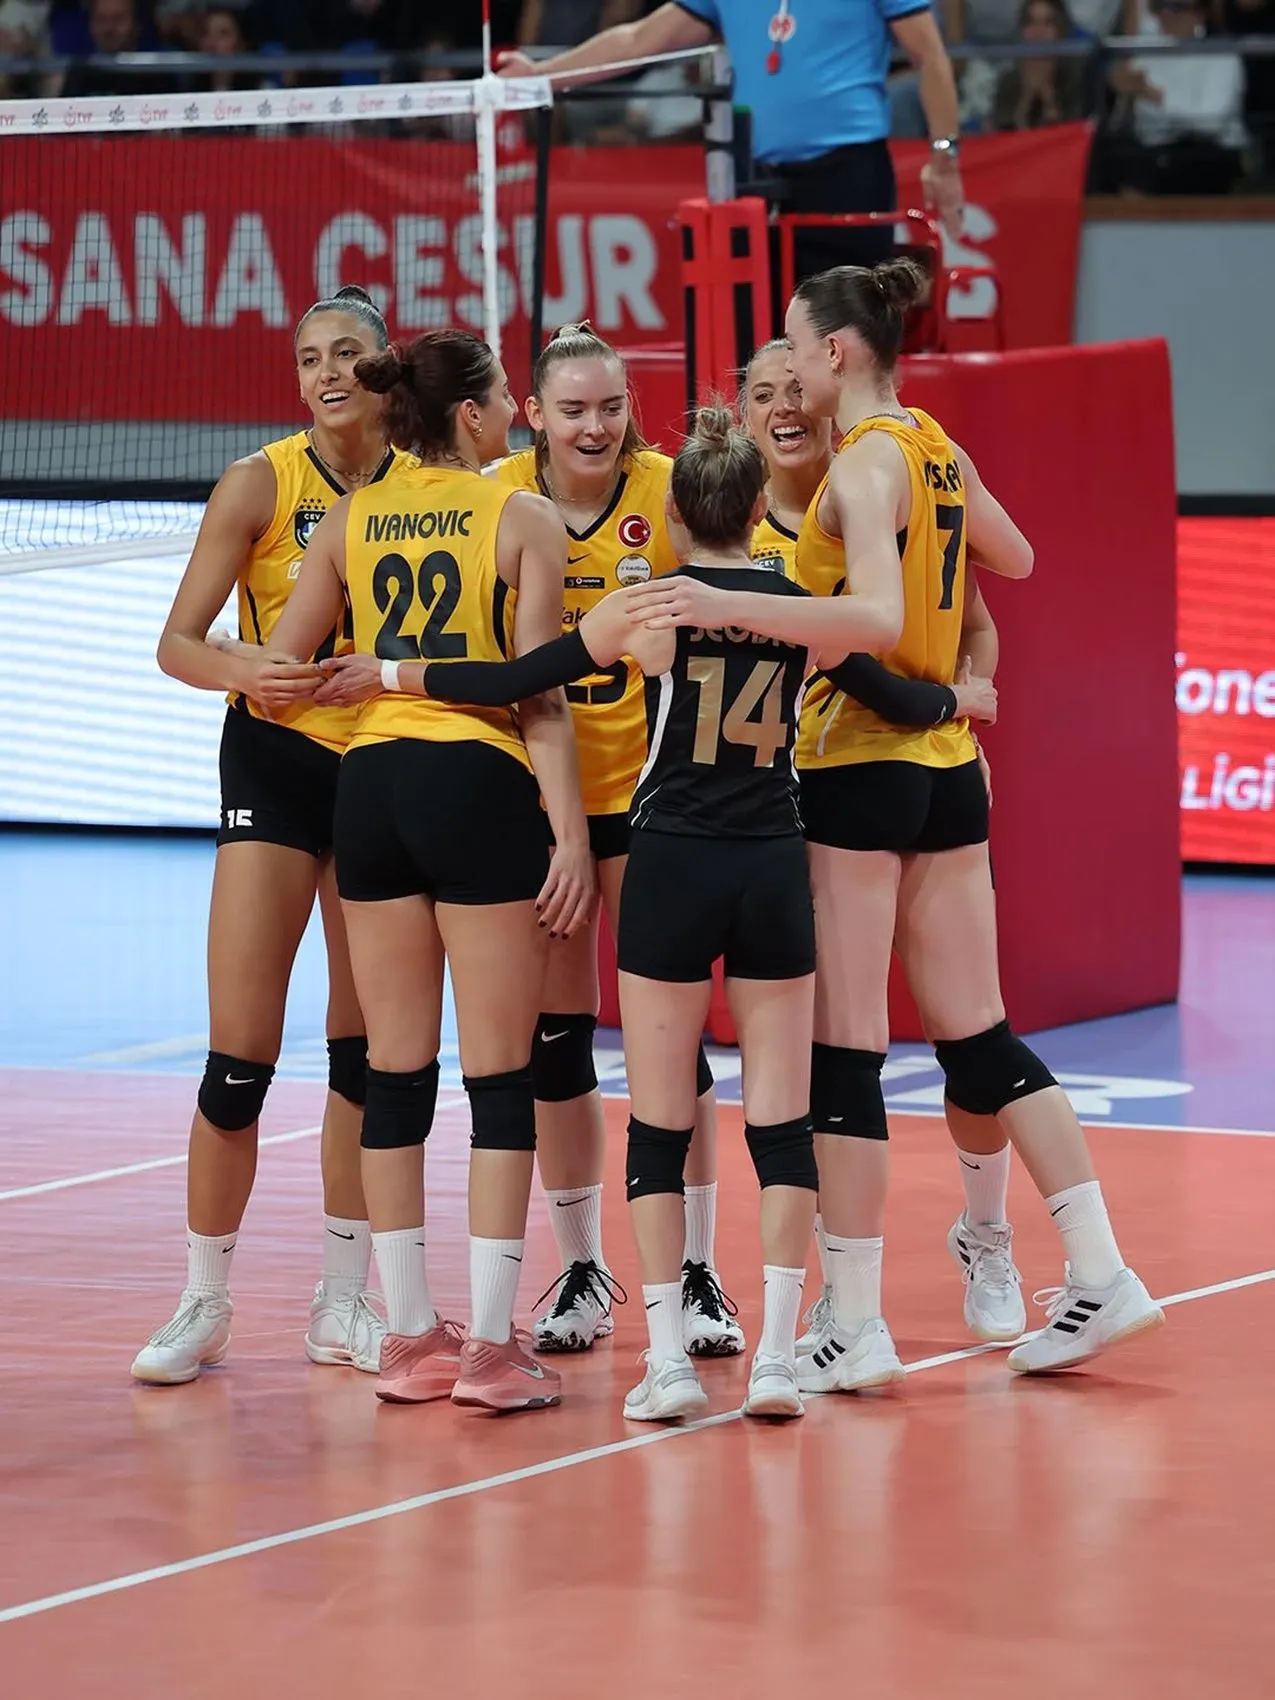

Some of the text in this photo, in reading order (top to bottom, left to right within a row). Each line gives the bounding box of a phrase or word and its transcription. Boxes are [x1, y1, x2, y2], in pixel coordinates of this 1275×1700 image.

[1, 210, 665, 331] SANA CESUR
[364, 509, 473, 543] IVANOVIC
[935, 503, 964, 610] 7
[372, 550, 468, 660] 22
[687, 656, 789, 769] 14
[1175, 651, 1275, 718] one
